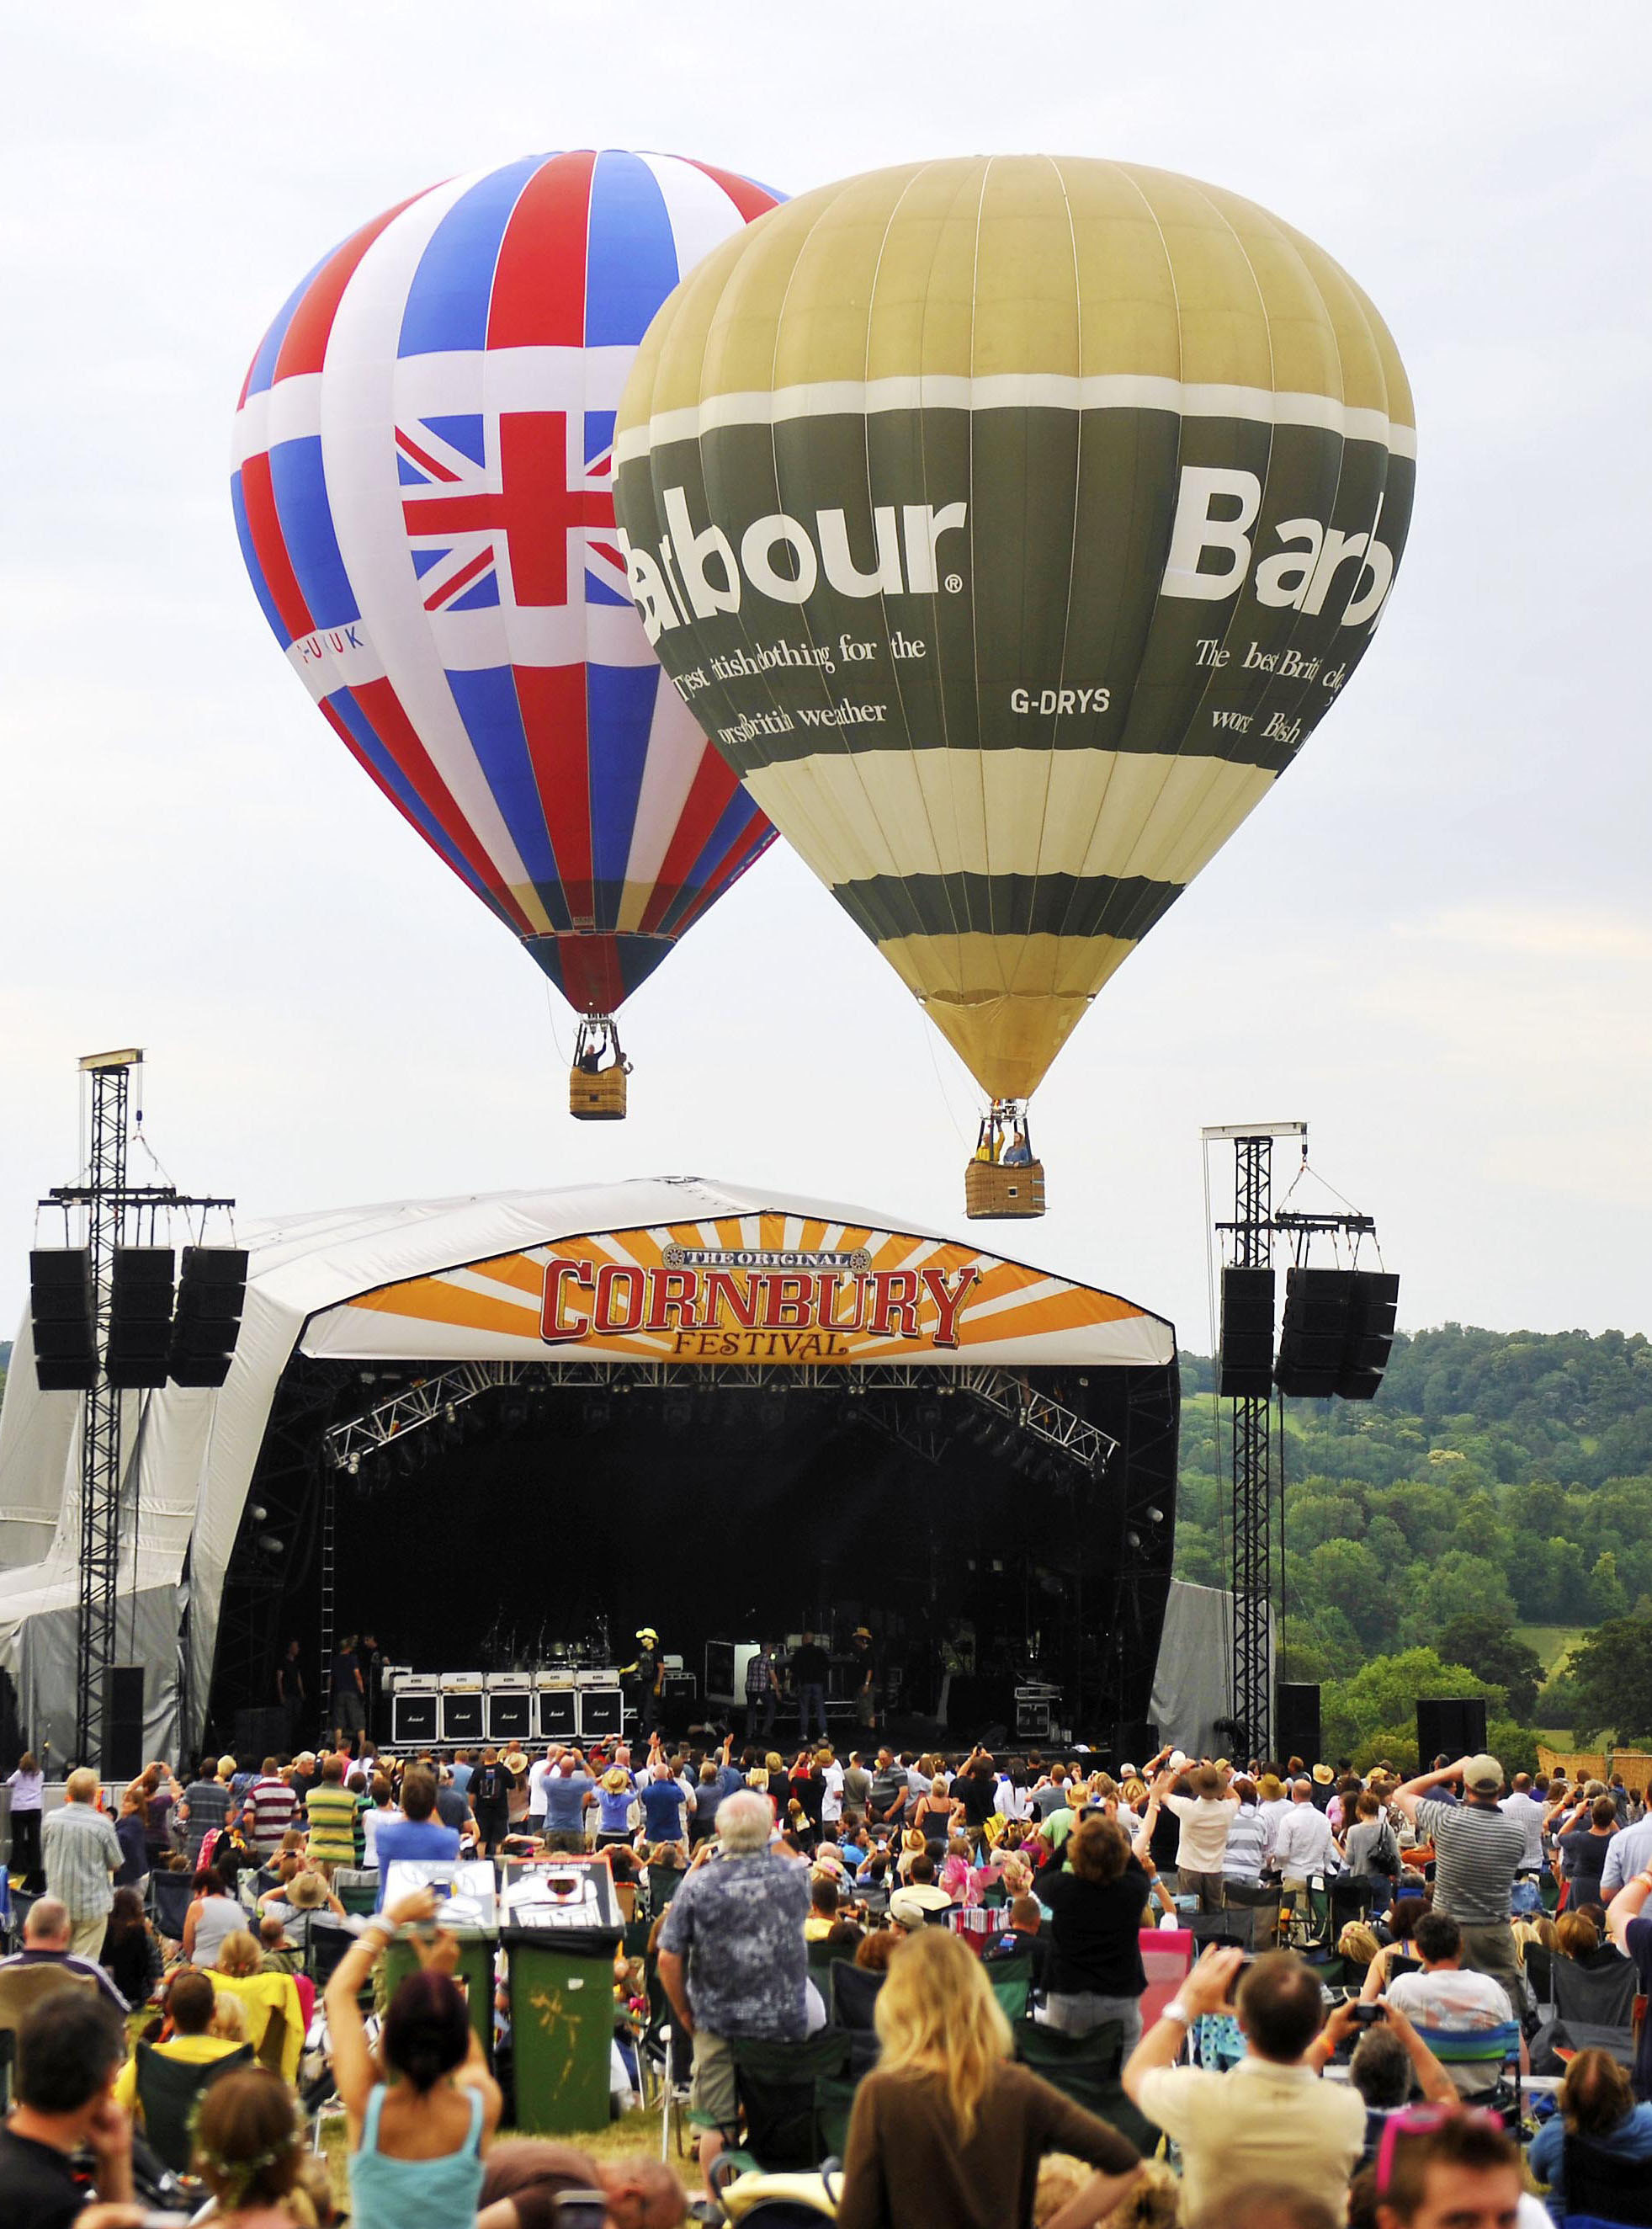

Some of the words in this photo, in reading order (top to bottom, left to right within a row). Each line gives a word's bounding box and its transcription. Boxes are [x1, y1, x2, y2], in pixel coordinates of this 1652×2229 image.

[838, 633, 877, 662] for
[891, 630, 927, 659] the
[1195, 639, 1230, 668] The
[797, 698, 887, 728] weather
[1011, 687, 1111, 715] G-DRYS
[687, 1251, 734, 1264] THE
[738, 1252, 850, 1266] ORIGINAL
[539, 1258, 982, 1348] CORNBURY
[673, 1332, 849, 1360] FESTIVAL
